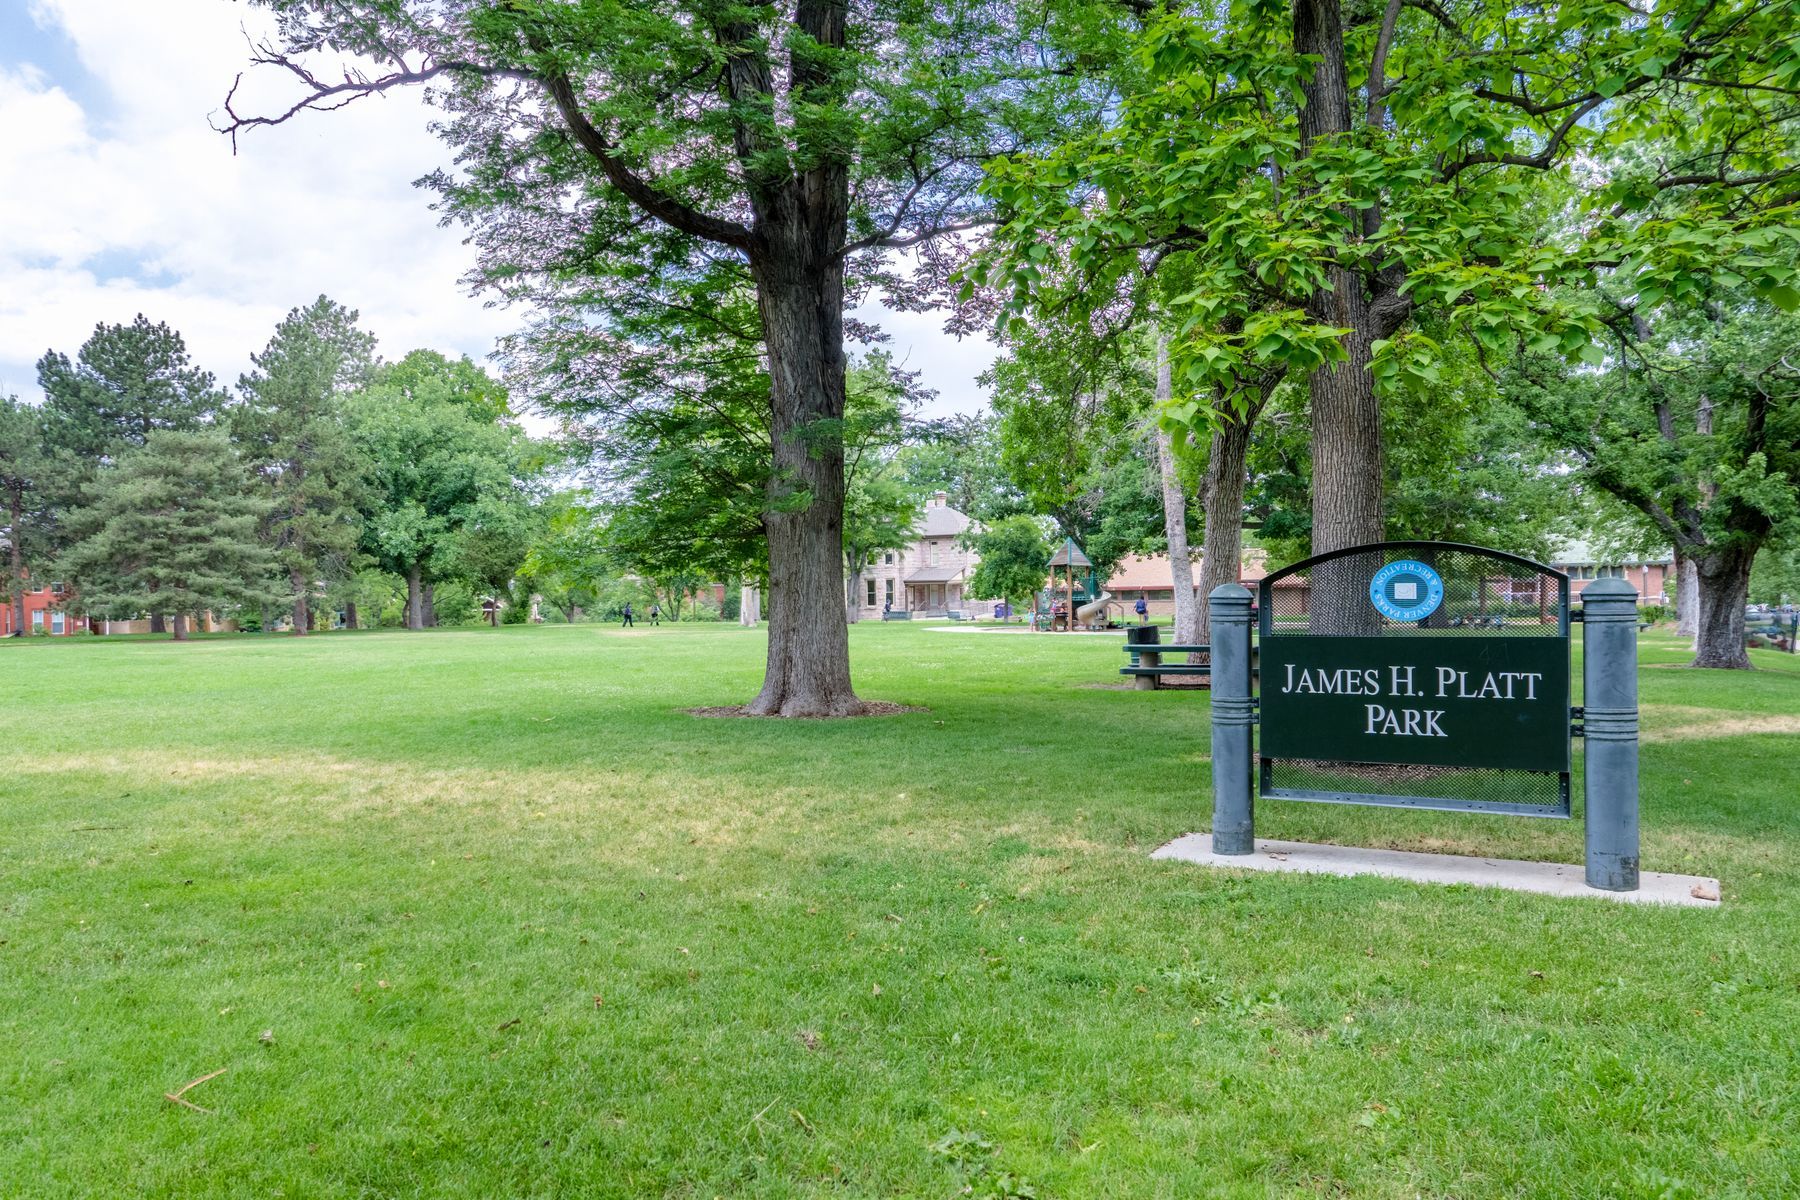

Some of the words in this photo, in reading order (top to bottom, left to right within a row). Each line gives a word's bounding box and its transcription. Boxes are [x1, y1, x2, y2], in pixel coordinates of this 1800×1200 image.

[1375, 563, 1433, 586] RECREATION
[1374, 593, 1401, 618] PARKS
[1403, 594, 1439, 619] DENVER
[1281, 663, 1380, 696] JAMES
[1388, 665, 1424, 697] H.
[1434, 666, 1543, 700] PLATT
[1364, 704, 1449, 737] PARK
